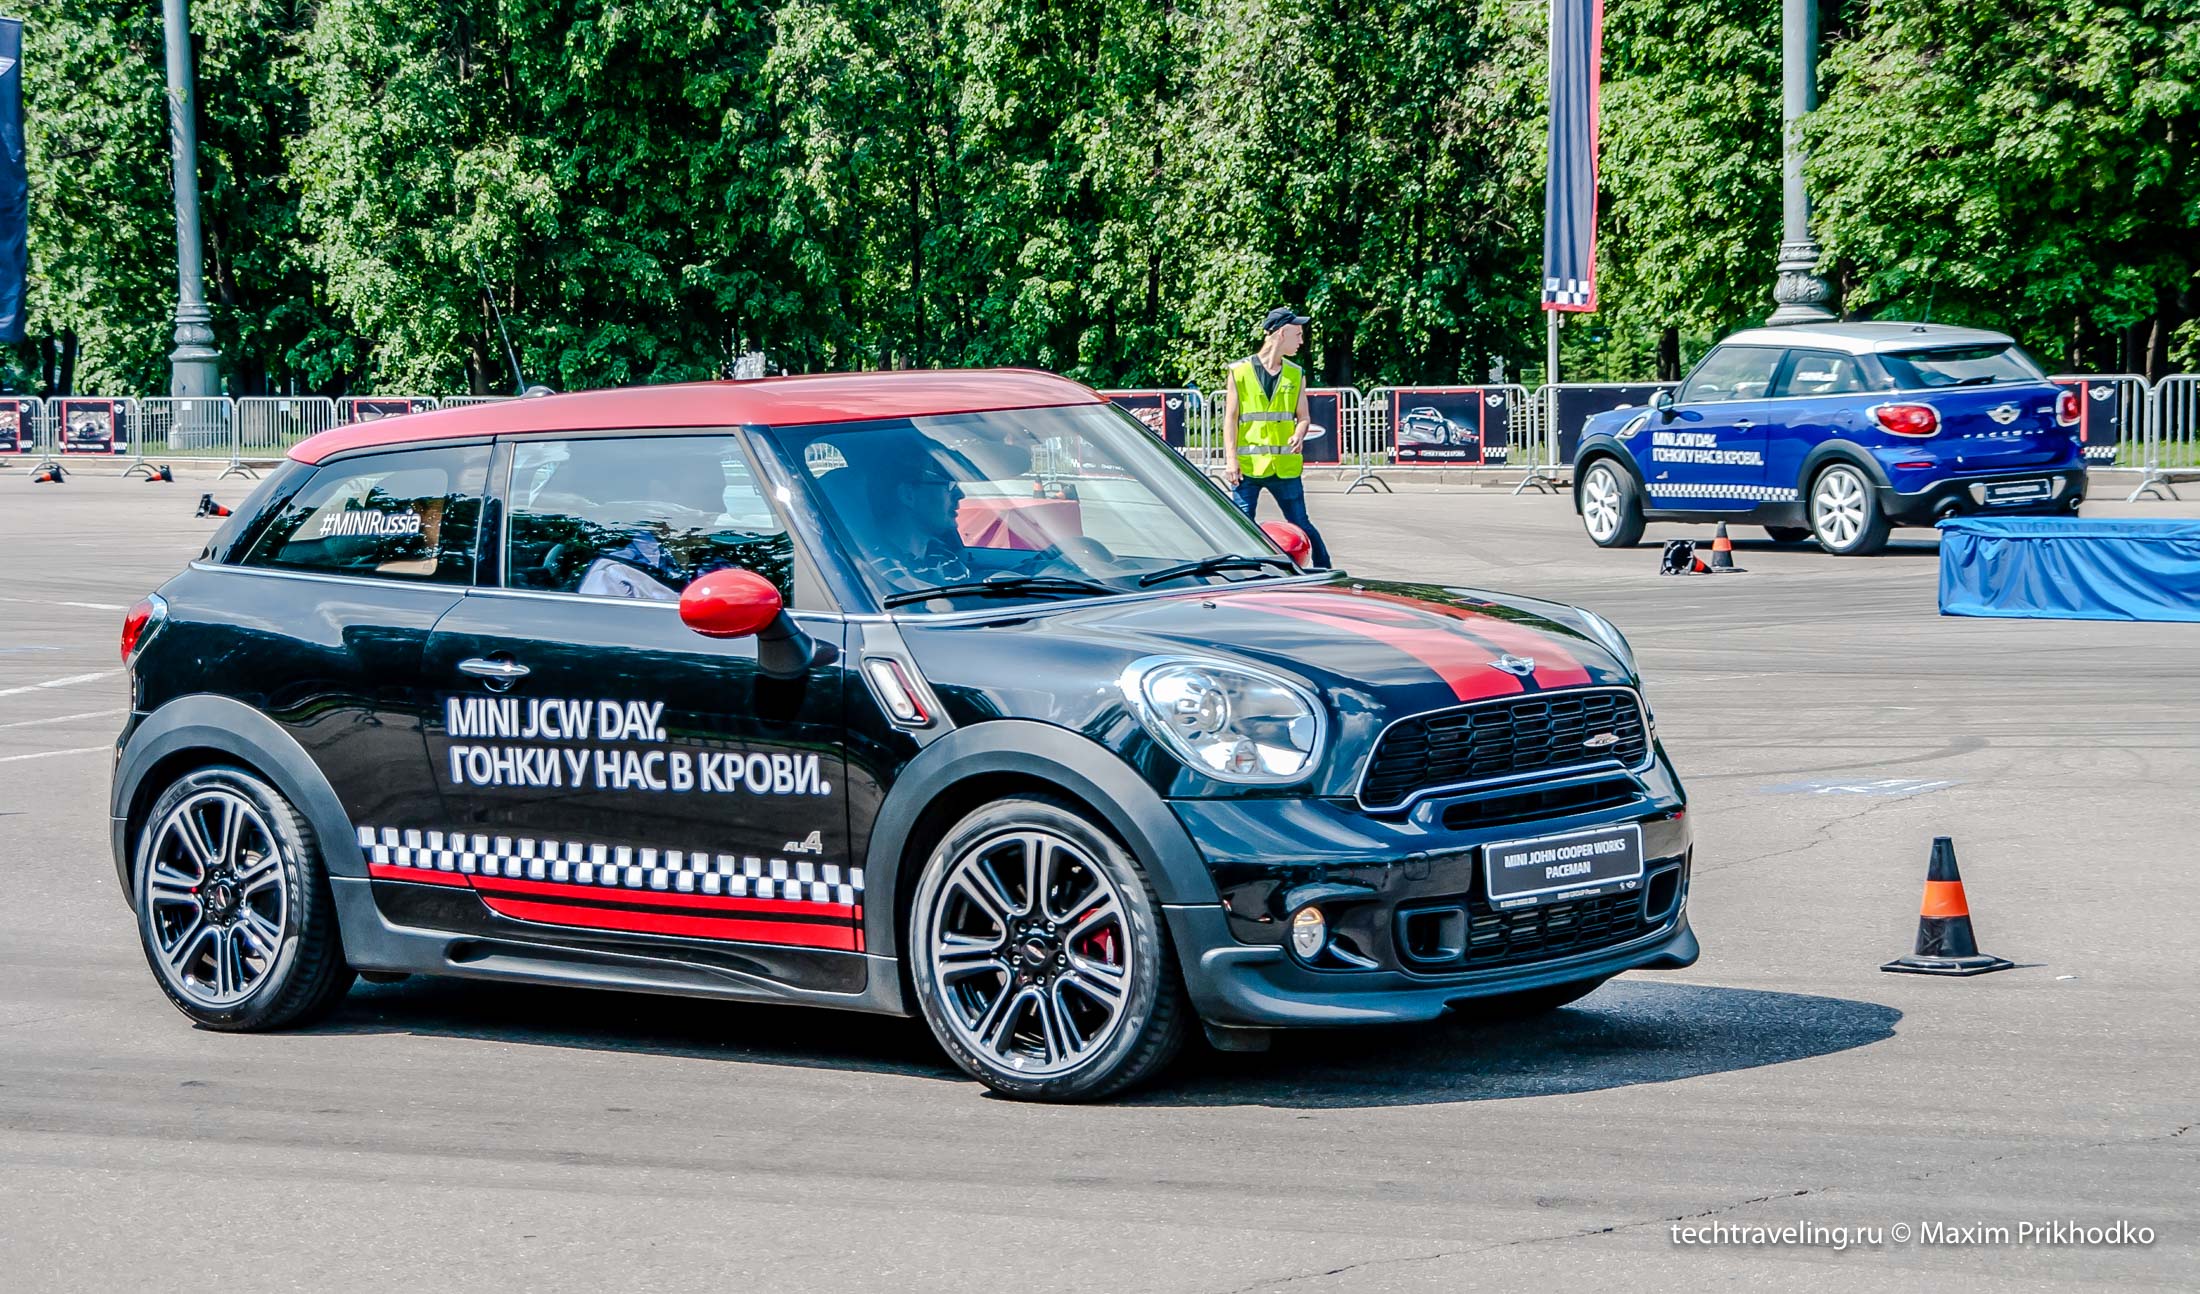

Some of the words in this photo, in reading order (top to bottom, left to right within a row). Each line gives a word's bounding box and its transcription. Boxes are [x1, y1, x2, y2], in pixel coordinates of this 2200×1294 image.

[320, 508, 421, 536] #MINIRussia
[447, 697, 520, 738] MINI
[521, 699, 593, 739] JCW
[598, 700, 667, 741] DAY.
[450, 745, 562, 787] ГОНКИ
[563, 748, 590, 787] У
[595, 749, 667, 790] НАС
[670, 751, 694, 791] В
[699, 752, 832, 796] КРОВИ.
[1504, 853, 1528, 868] MINI
[1528, 849, 1557, 865] JOHN
[1556, 843, 1594, 861] COOPER
[1593, 838, 1627, 855] WORKS
[1545, 861, 1592, 880] PACEMAN
